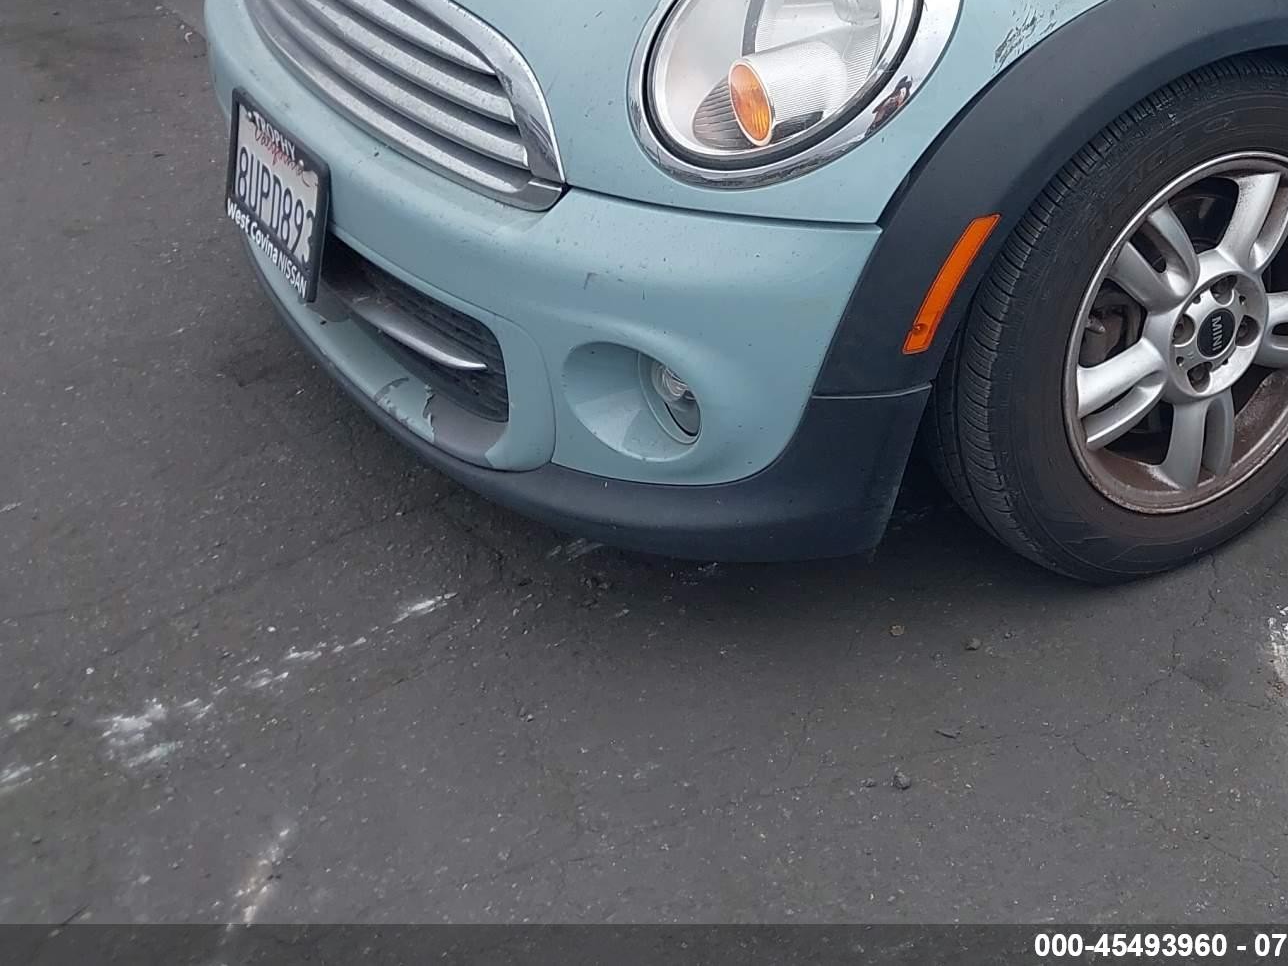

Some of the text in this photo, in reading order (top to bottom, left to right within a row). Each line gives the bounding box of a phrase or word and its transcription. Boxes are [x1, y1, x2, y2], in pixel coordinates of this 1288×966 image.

[252, 110, 296, 161] TROPHY
[227, 197, 308, 299] West Covina NISSAN
[1212, 316, 1223, 351] MINI
